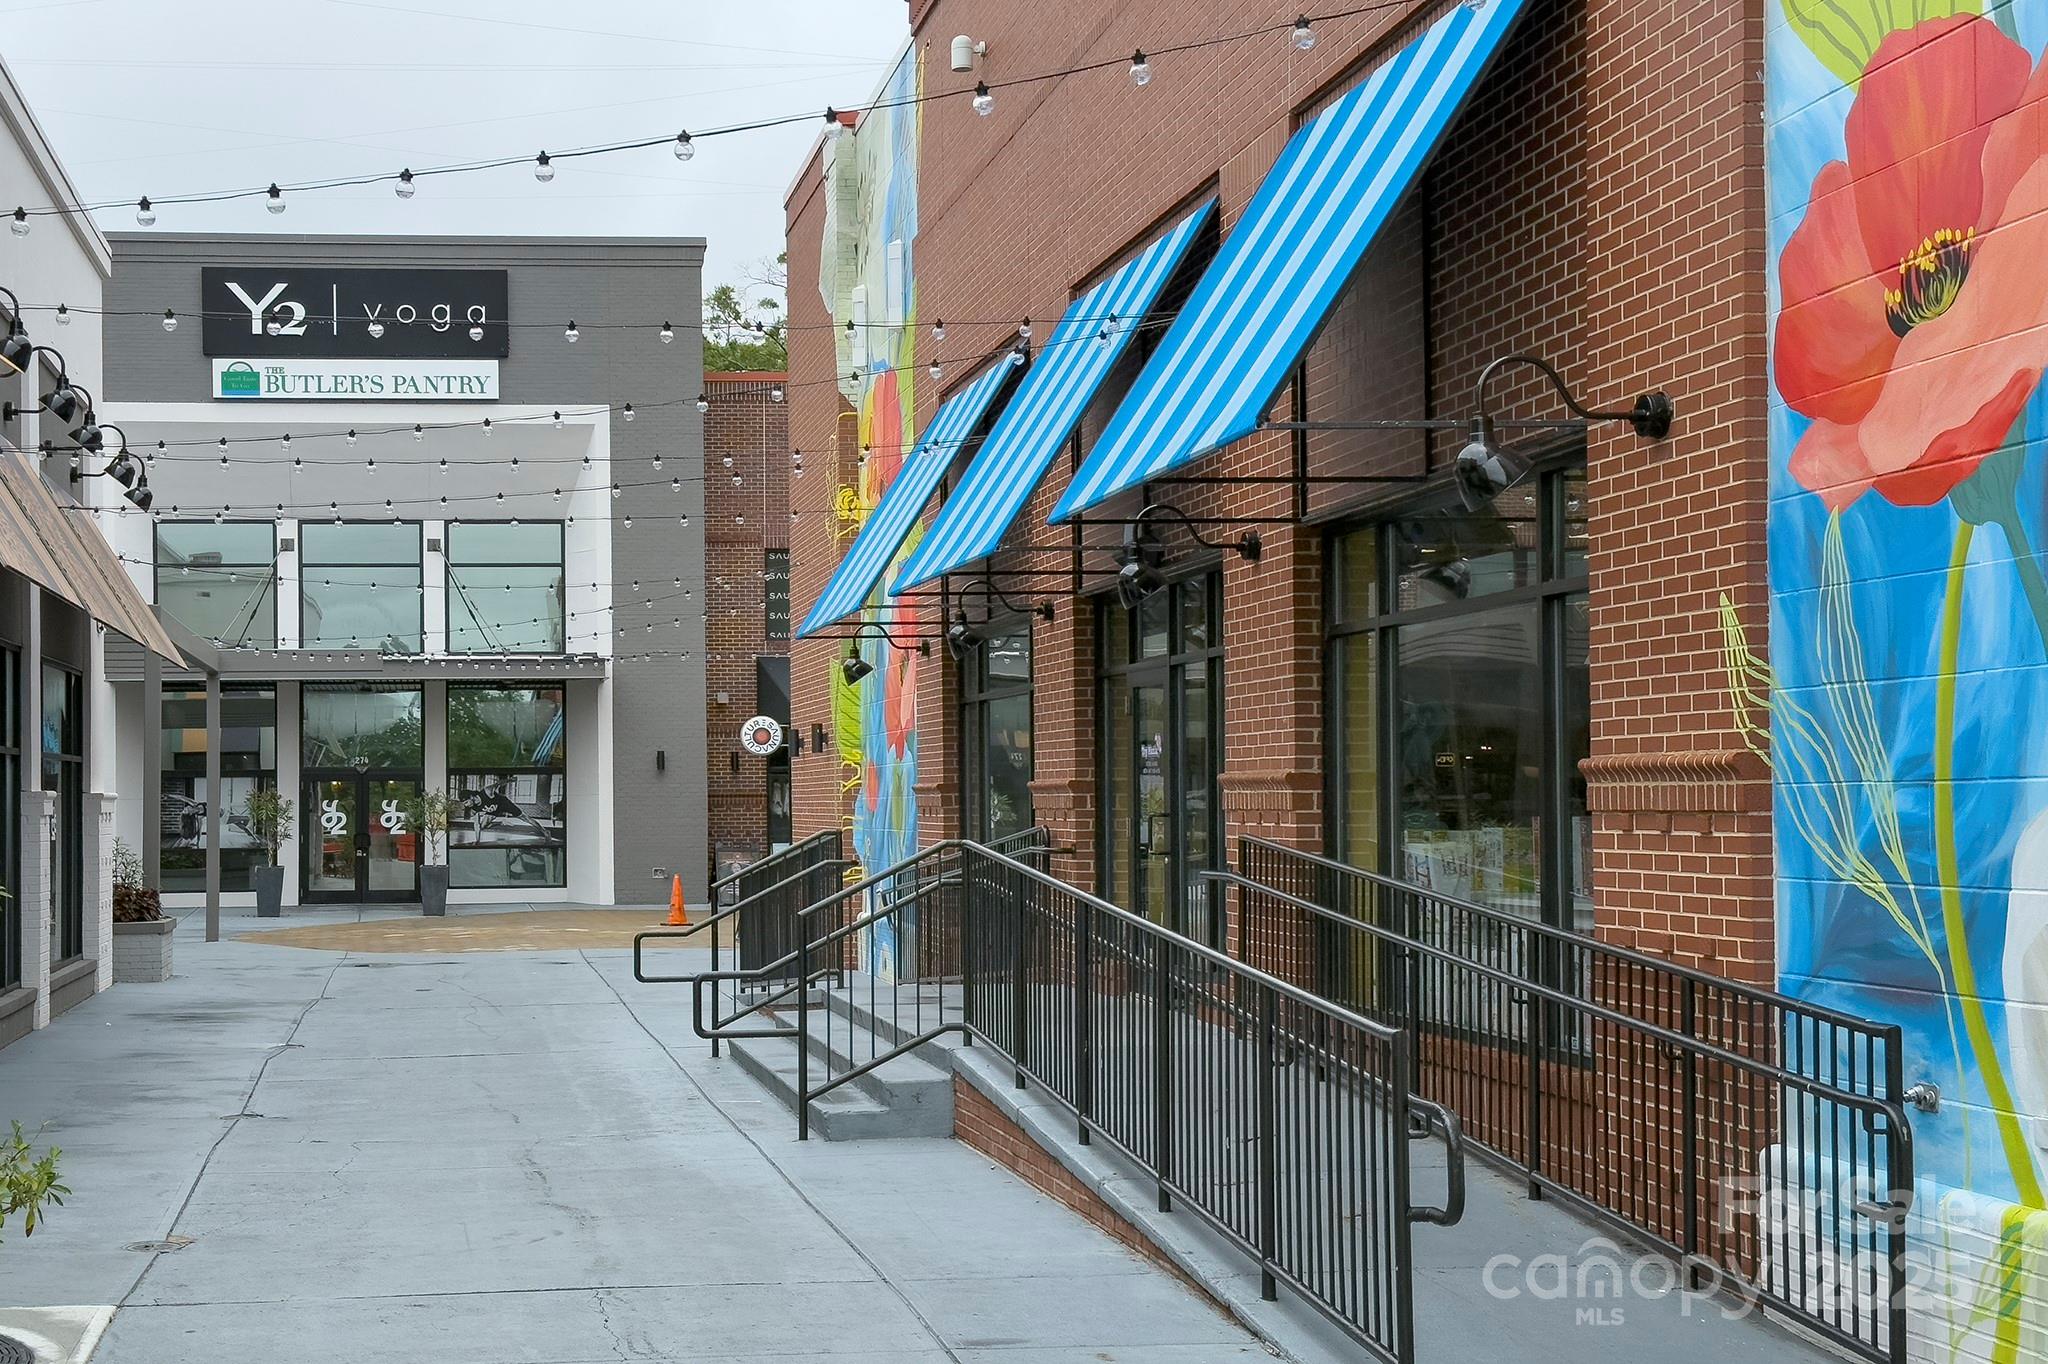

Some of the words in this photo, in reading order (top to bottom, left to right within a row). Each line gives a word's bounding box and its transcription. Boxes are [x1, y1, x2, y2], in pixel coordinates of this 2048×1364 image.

[224, 282, 307, 336] Y2
[264, 366, 285, 374] THE
[264, 374, 385, 394] BUTLER'S
[391, 375, 491, 395] PANTRY
